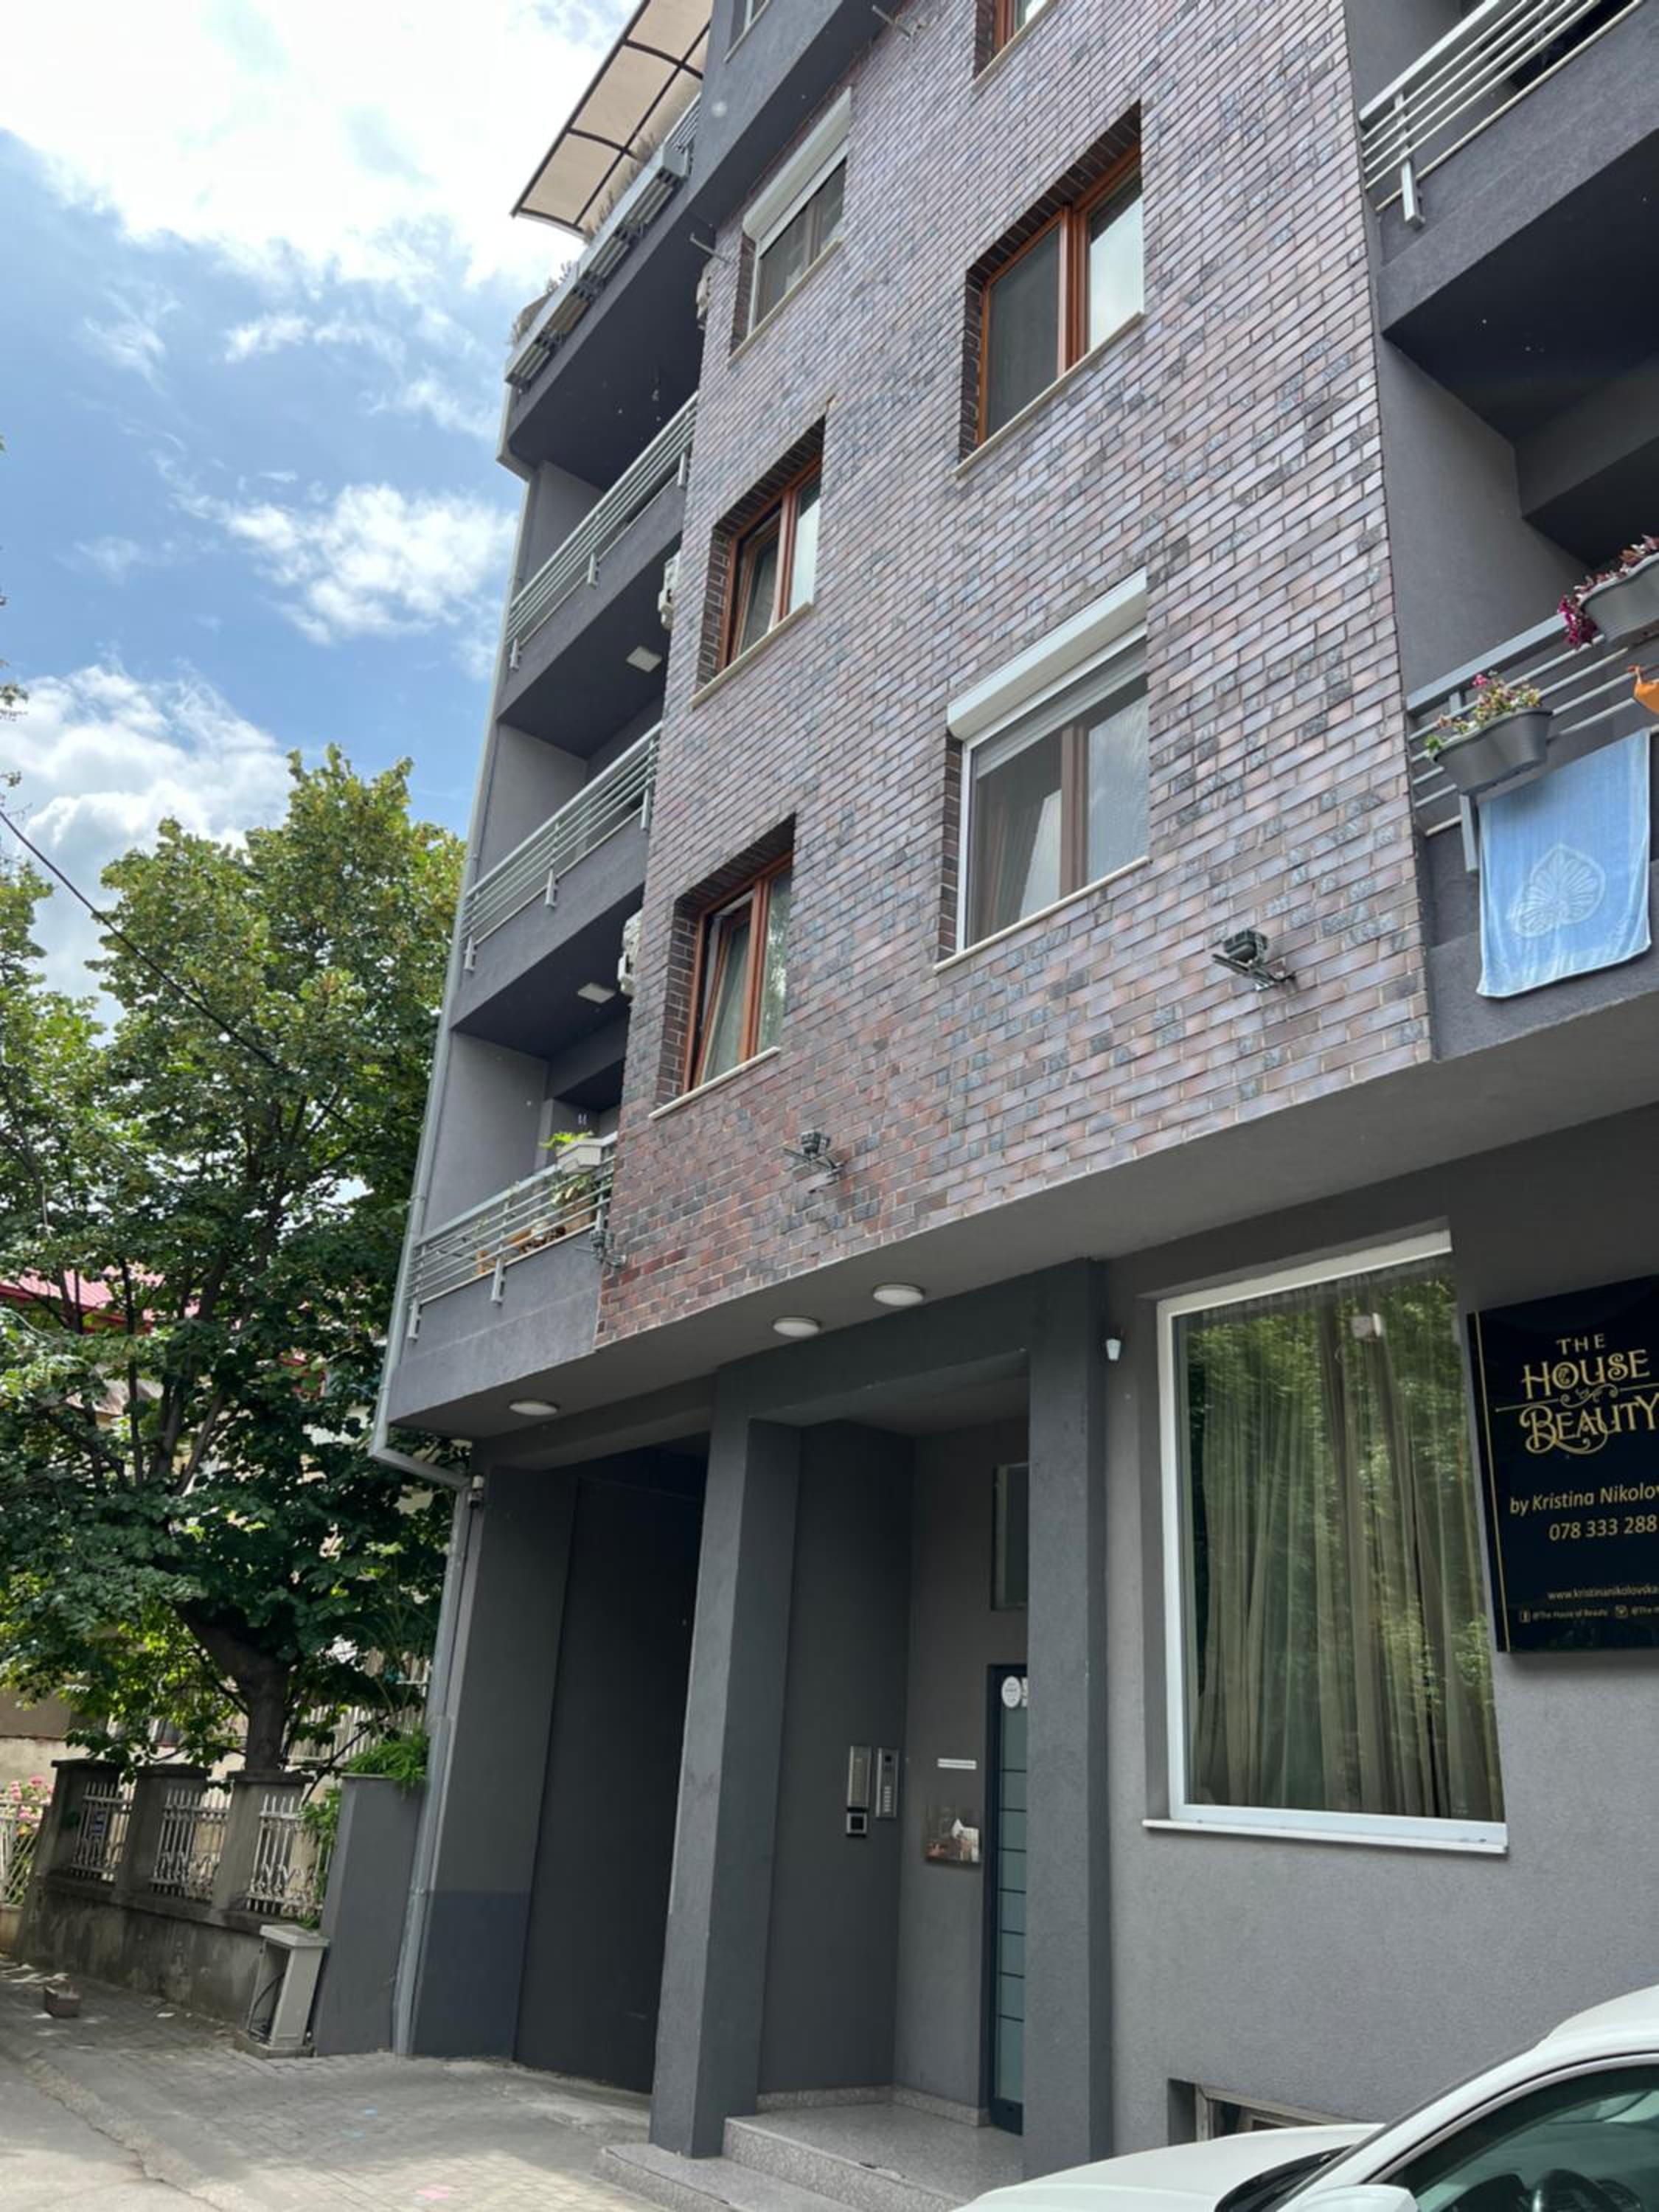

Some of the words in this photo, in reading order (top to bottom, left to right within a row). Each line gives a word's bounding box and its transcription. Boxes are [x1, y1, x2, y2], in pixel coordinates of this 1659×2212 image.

[1556, 1333, 1605, 1355] THE
[1521, 1349, 1651, 1399] HOUSE
[1520, 1392, 1659, 1454] BEAUTY
[1510, 1497, 1529, 1517] by
[1532, 1490, 1594, 1511] Kristina
[1599, 1482, 1659, 1505] Nikolo
[1549, 1521, 1582, 1541] 078
[1586, 1517, 1618, 1537] 333
[1624, 1514, 1658, 1534] 288
